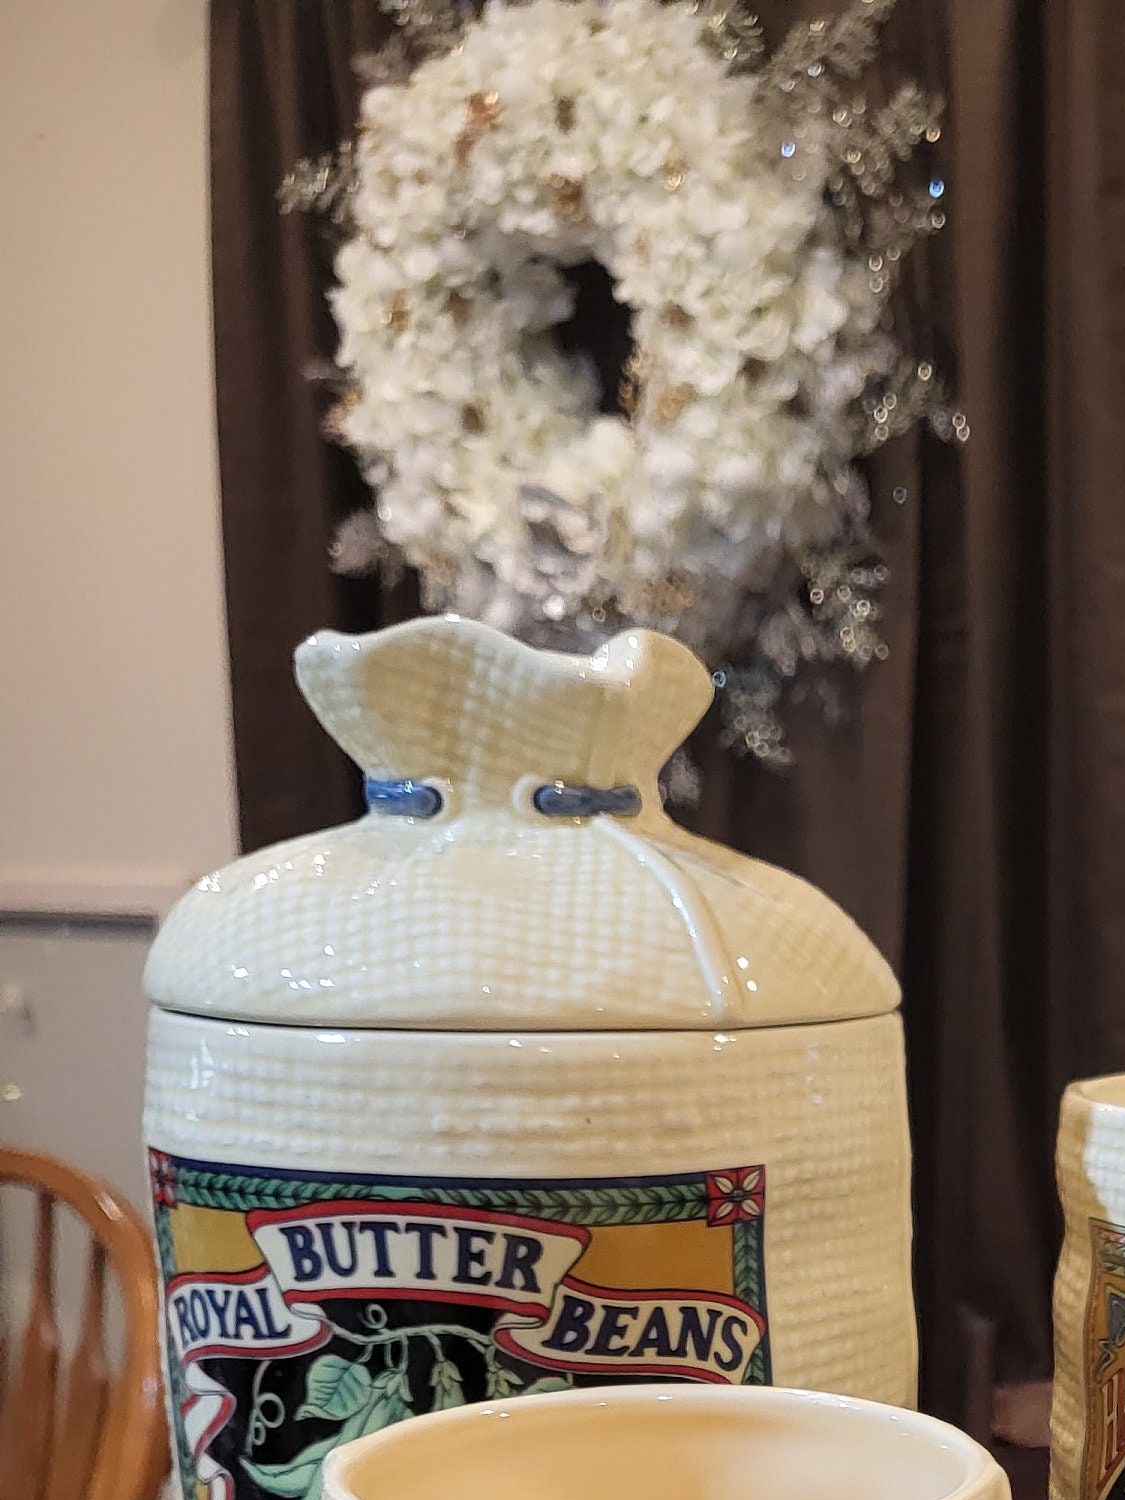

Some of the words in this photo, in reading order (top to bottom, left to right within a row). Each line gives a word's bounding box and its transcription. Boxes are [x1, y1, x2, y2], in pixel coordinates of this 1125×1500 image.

[278, 1221, 544, 1293] BUTTER
[172, 1288, 292, 1346] ROYAL
[543, 1294, 750, 1370] BEANS
